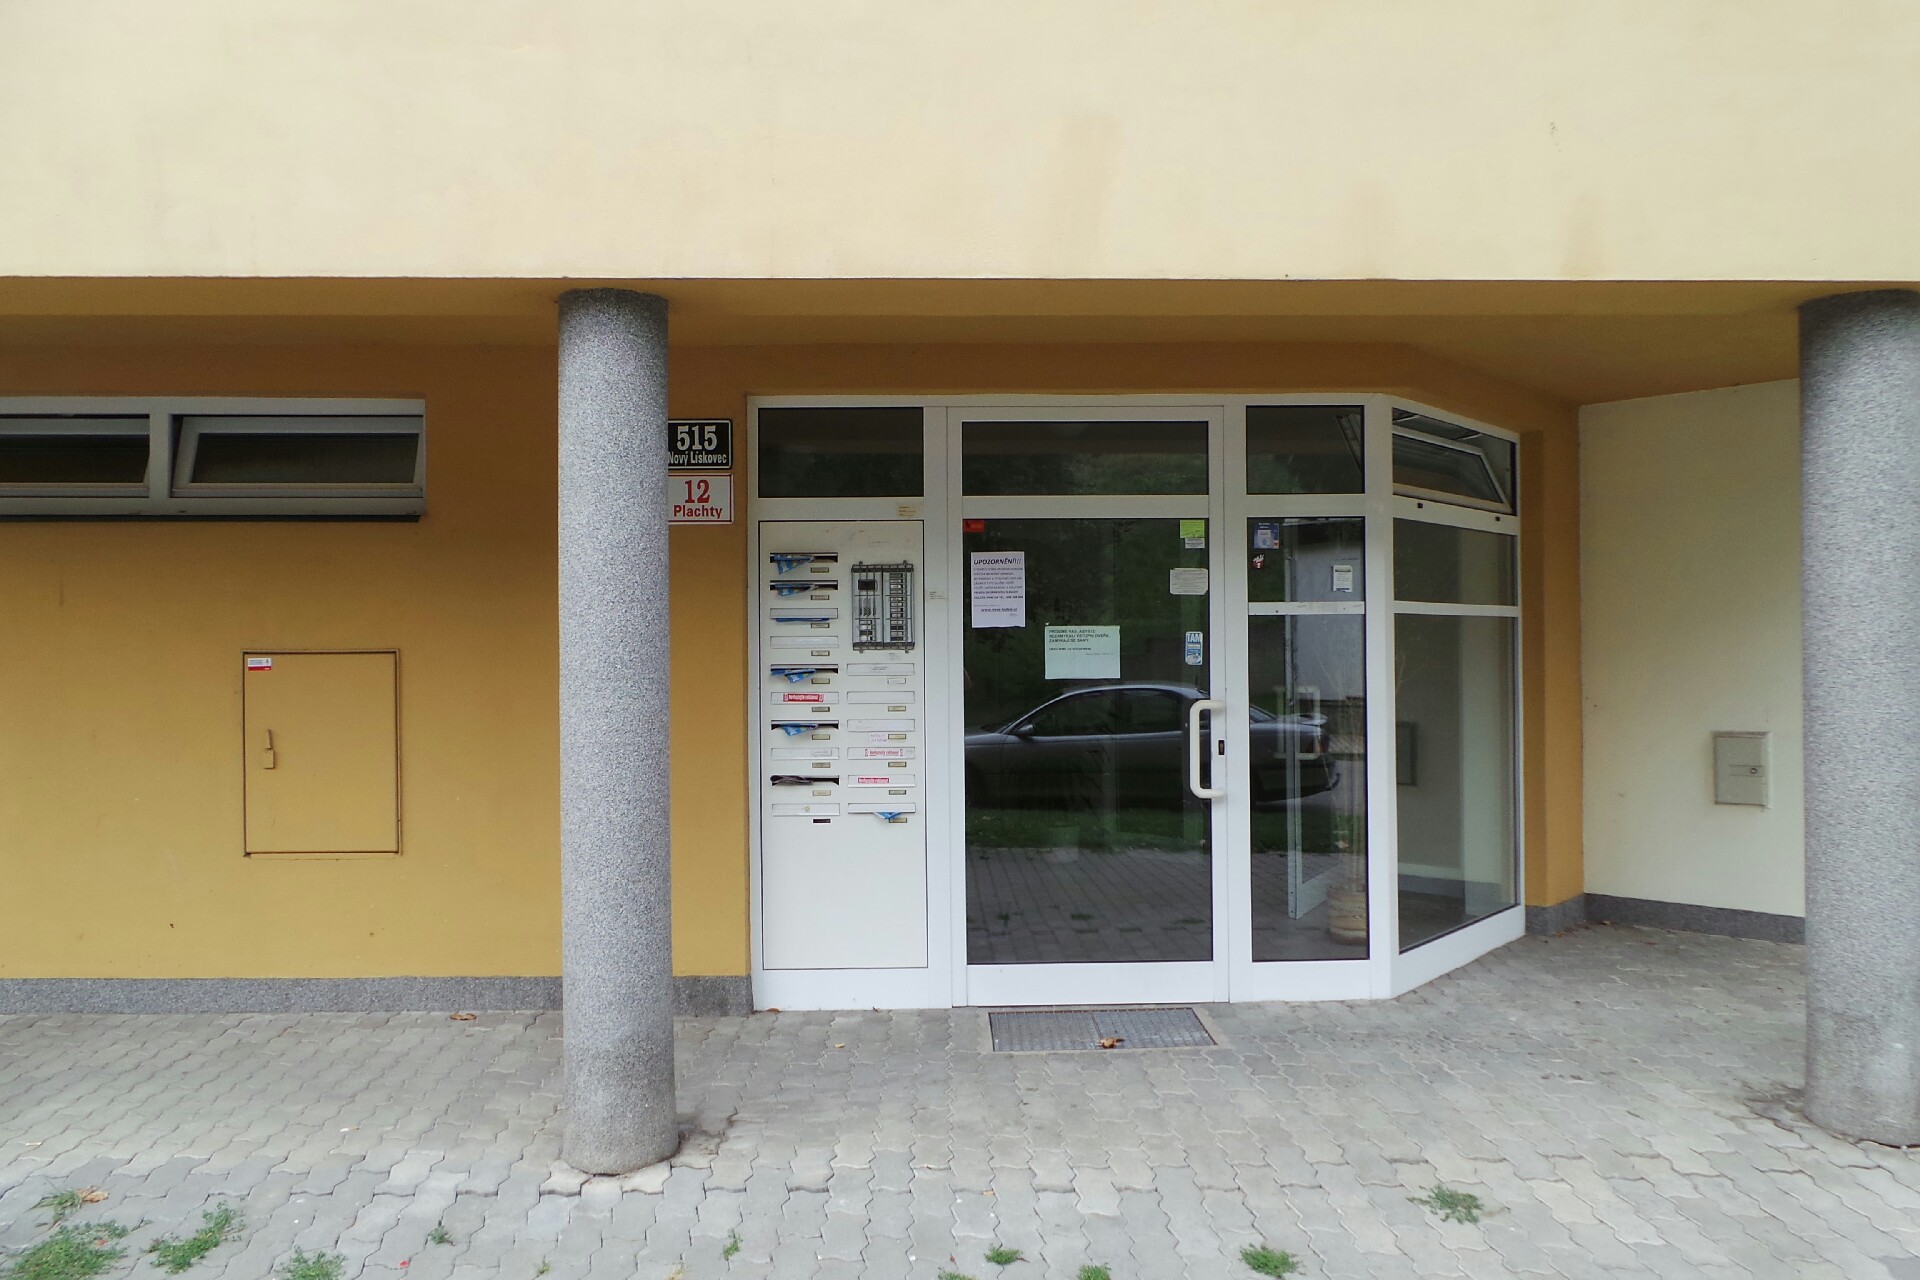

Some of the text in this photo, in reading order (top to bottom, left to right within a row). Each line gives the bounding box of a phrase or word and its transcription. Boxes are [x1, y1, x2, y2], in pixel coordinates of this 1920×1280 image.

[676, 425, 718, 450] 515
[667, 450, 727, 466] Nový Lískovec
[684, 479, 710, 503] 12
[673, 505, 723, 519] Plachty
